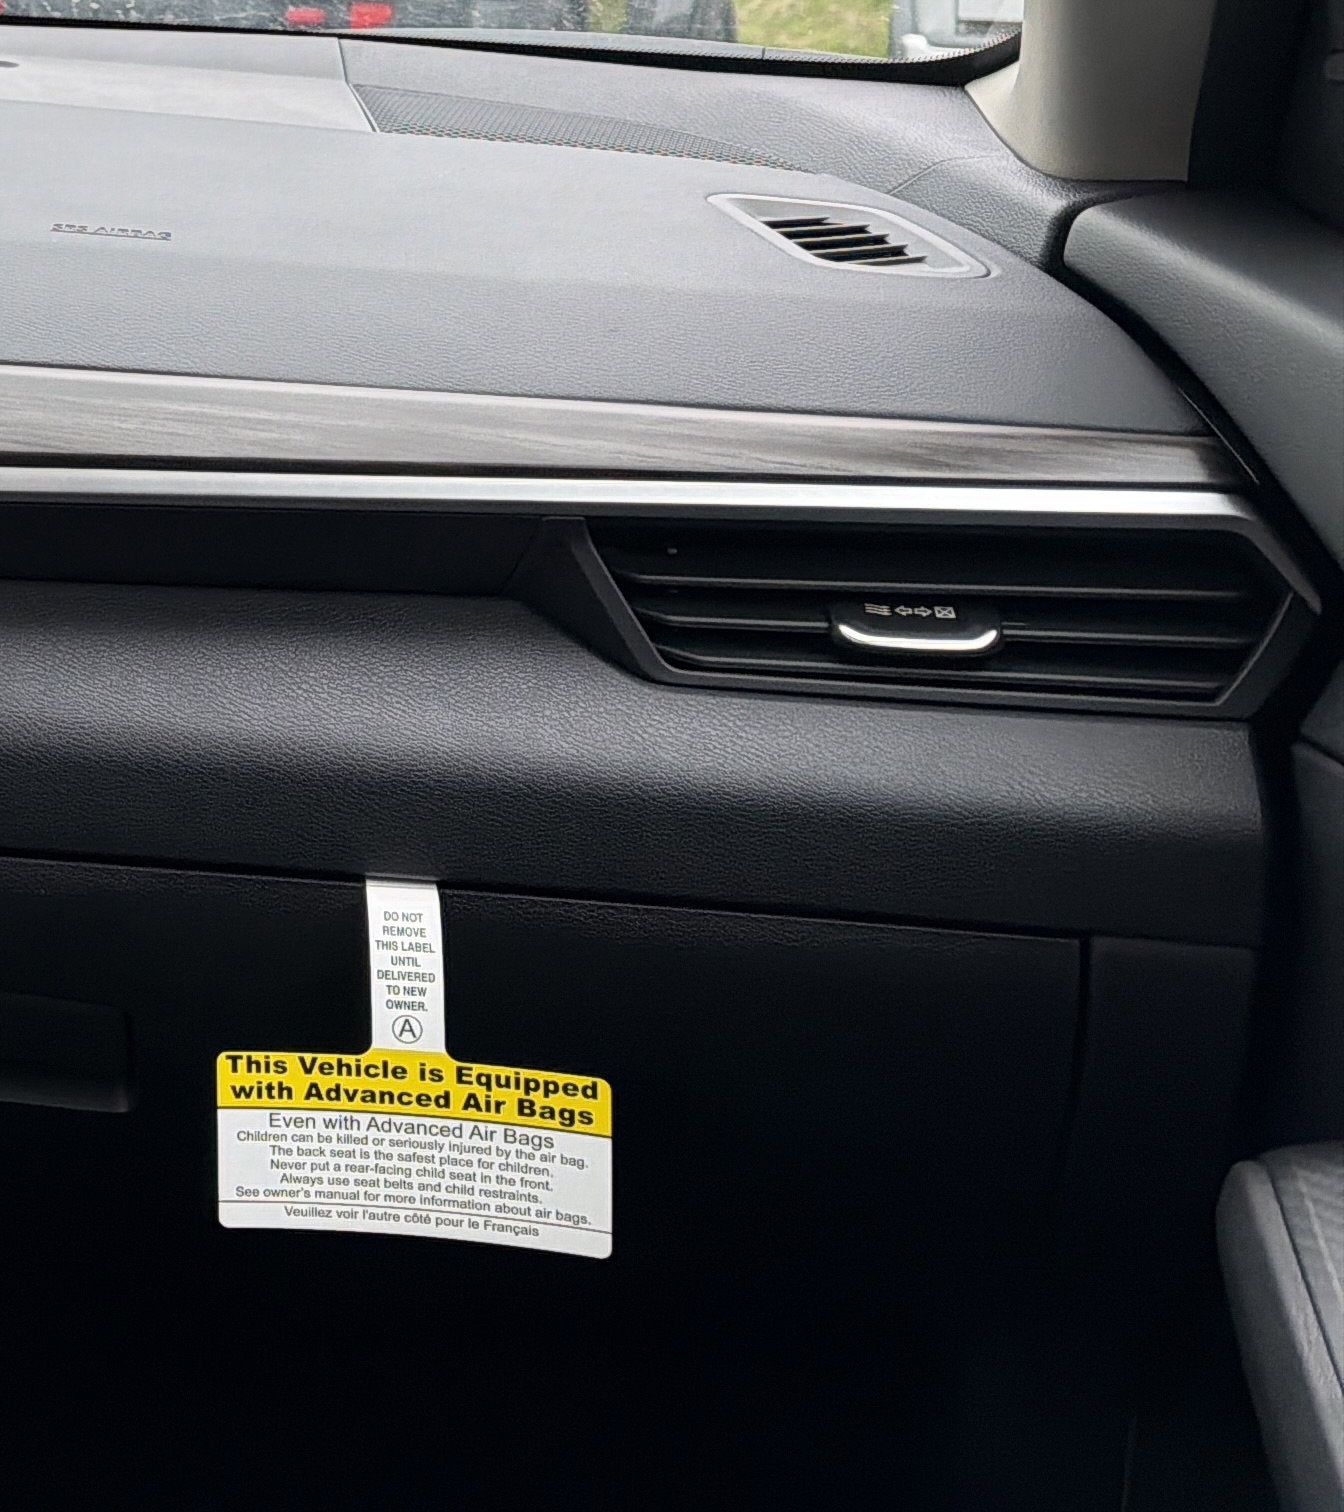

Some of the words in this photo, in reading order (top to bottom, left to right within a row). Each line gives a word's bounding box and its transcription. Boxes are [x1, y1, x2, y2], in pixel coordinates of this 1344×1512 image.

[382, 926, 426, 938] REMOVE
[383, 911, 399, 922] DO
[402, 912, 424, 923] NOT
[375, 940, 398, 951] THIS
[401, 942, 436, 953] LABEL
[390, 956, 421, 967] UNTIL
[377, 970, 436, 983] DELIVERED
[386, 985, 400, 995] TO
[403, 986, 427, 997] NEW
[385, 999, 428, 1012] OWNER.
[398, 1018, 416, 1039] A
[225, 1054, 289, 1075] This
[298, 1055, 408, 1080] Vehicle
[419, 1062, 444, 1083] is
[455, 1065, 600, 1101] Equipped
[230, 1081, 293, 1101] with
[303, 1081, 451, 1110] Advanced
[461, 1093, 507, 1115] Air
[517, 1096, 595, 1127] Bags
[268, 1112, 317, 1131] Even
[322, 1114, 360, 1131] with
[367, 1116, 464, 1139] Advanced
[468, 1124, 497, 1142] Air
[503, 1128, 555, 1150] Bags
[237, 1131, 288, 1142] Children
[291, 1133, 313, 1143] can
[317, 1132, 333, 1144] be
[336, 1133, 368, 1146] killed
[371, 1136, 385, 1147] or
[388, 1137, 445, 1153] seriously
[448, 1141, 492, 1156] injured
[496, 1146, 511, 1160] by
[515, 1148, 535, 1161] the
[540, 1151, 556, 1164] air
[560, 1154, 589, 1170] bag.
[269, 1145, 293, 1157] The
[297, 1146, 326, 1158] back
[329, 1148, 356, 1159] seat
[359, 1148, 370, 1160] is
[374, 1150, 394, 1161] the
[397, 1151, 436, 1164] safest
[439, 1154, 473, 1168] place
[477, 1158, 495, 1170] for
[498, 1160, 554, 1178] children.
[270, 1159, 307, 1171] Never
[310, 1161, 330, 1173] put
[333, 1164, 341, 1173] a
[344, 1163, 412, 1178] rear-facing
[416, 1167, 445, 1179] child
[449, 1170, 477, 1182] seat
[480, 1172, 492, 1184] in
[496, 1173, 516, 1186] the
[520, 1176, 554, 1192] front.
[280, 1173, 324, 1187] Always
[327, 1176, 350, 1186] use
[353, 1177, 380, 1188] seat
[384, 1178, 414, 1191] belts
[418, 1182, 441, 1193] and
[445, 1184, 474, 1197] child
[478, 1187, 543, 1204] restraints.
[235, 1186, 260, 1197] See
[263, 1187, 312, 1199] owner's
[315, 1189, 360, 1201] manual
[364, 1191, 381, 1202] for
[384, 1194, 416, 1205] more
[419, 1194, 491, 1212] information
[495, 1202, 532, 1217] about
[535, 1207, 552, 1219] air
[555, 1209, 592, 1226] bags.
[284, 1205, 332, 1218] Veuillez
[336, 1207, 359, 1219] voir
[362, 1209, 401, 1222] l'autre
[404, 1212, 432, 1225] côté
[435, 1216, 465, 1229] pour
[468, 1217, 480, 1230] le
[483, 1219, 539, 1237] Français
